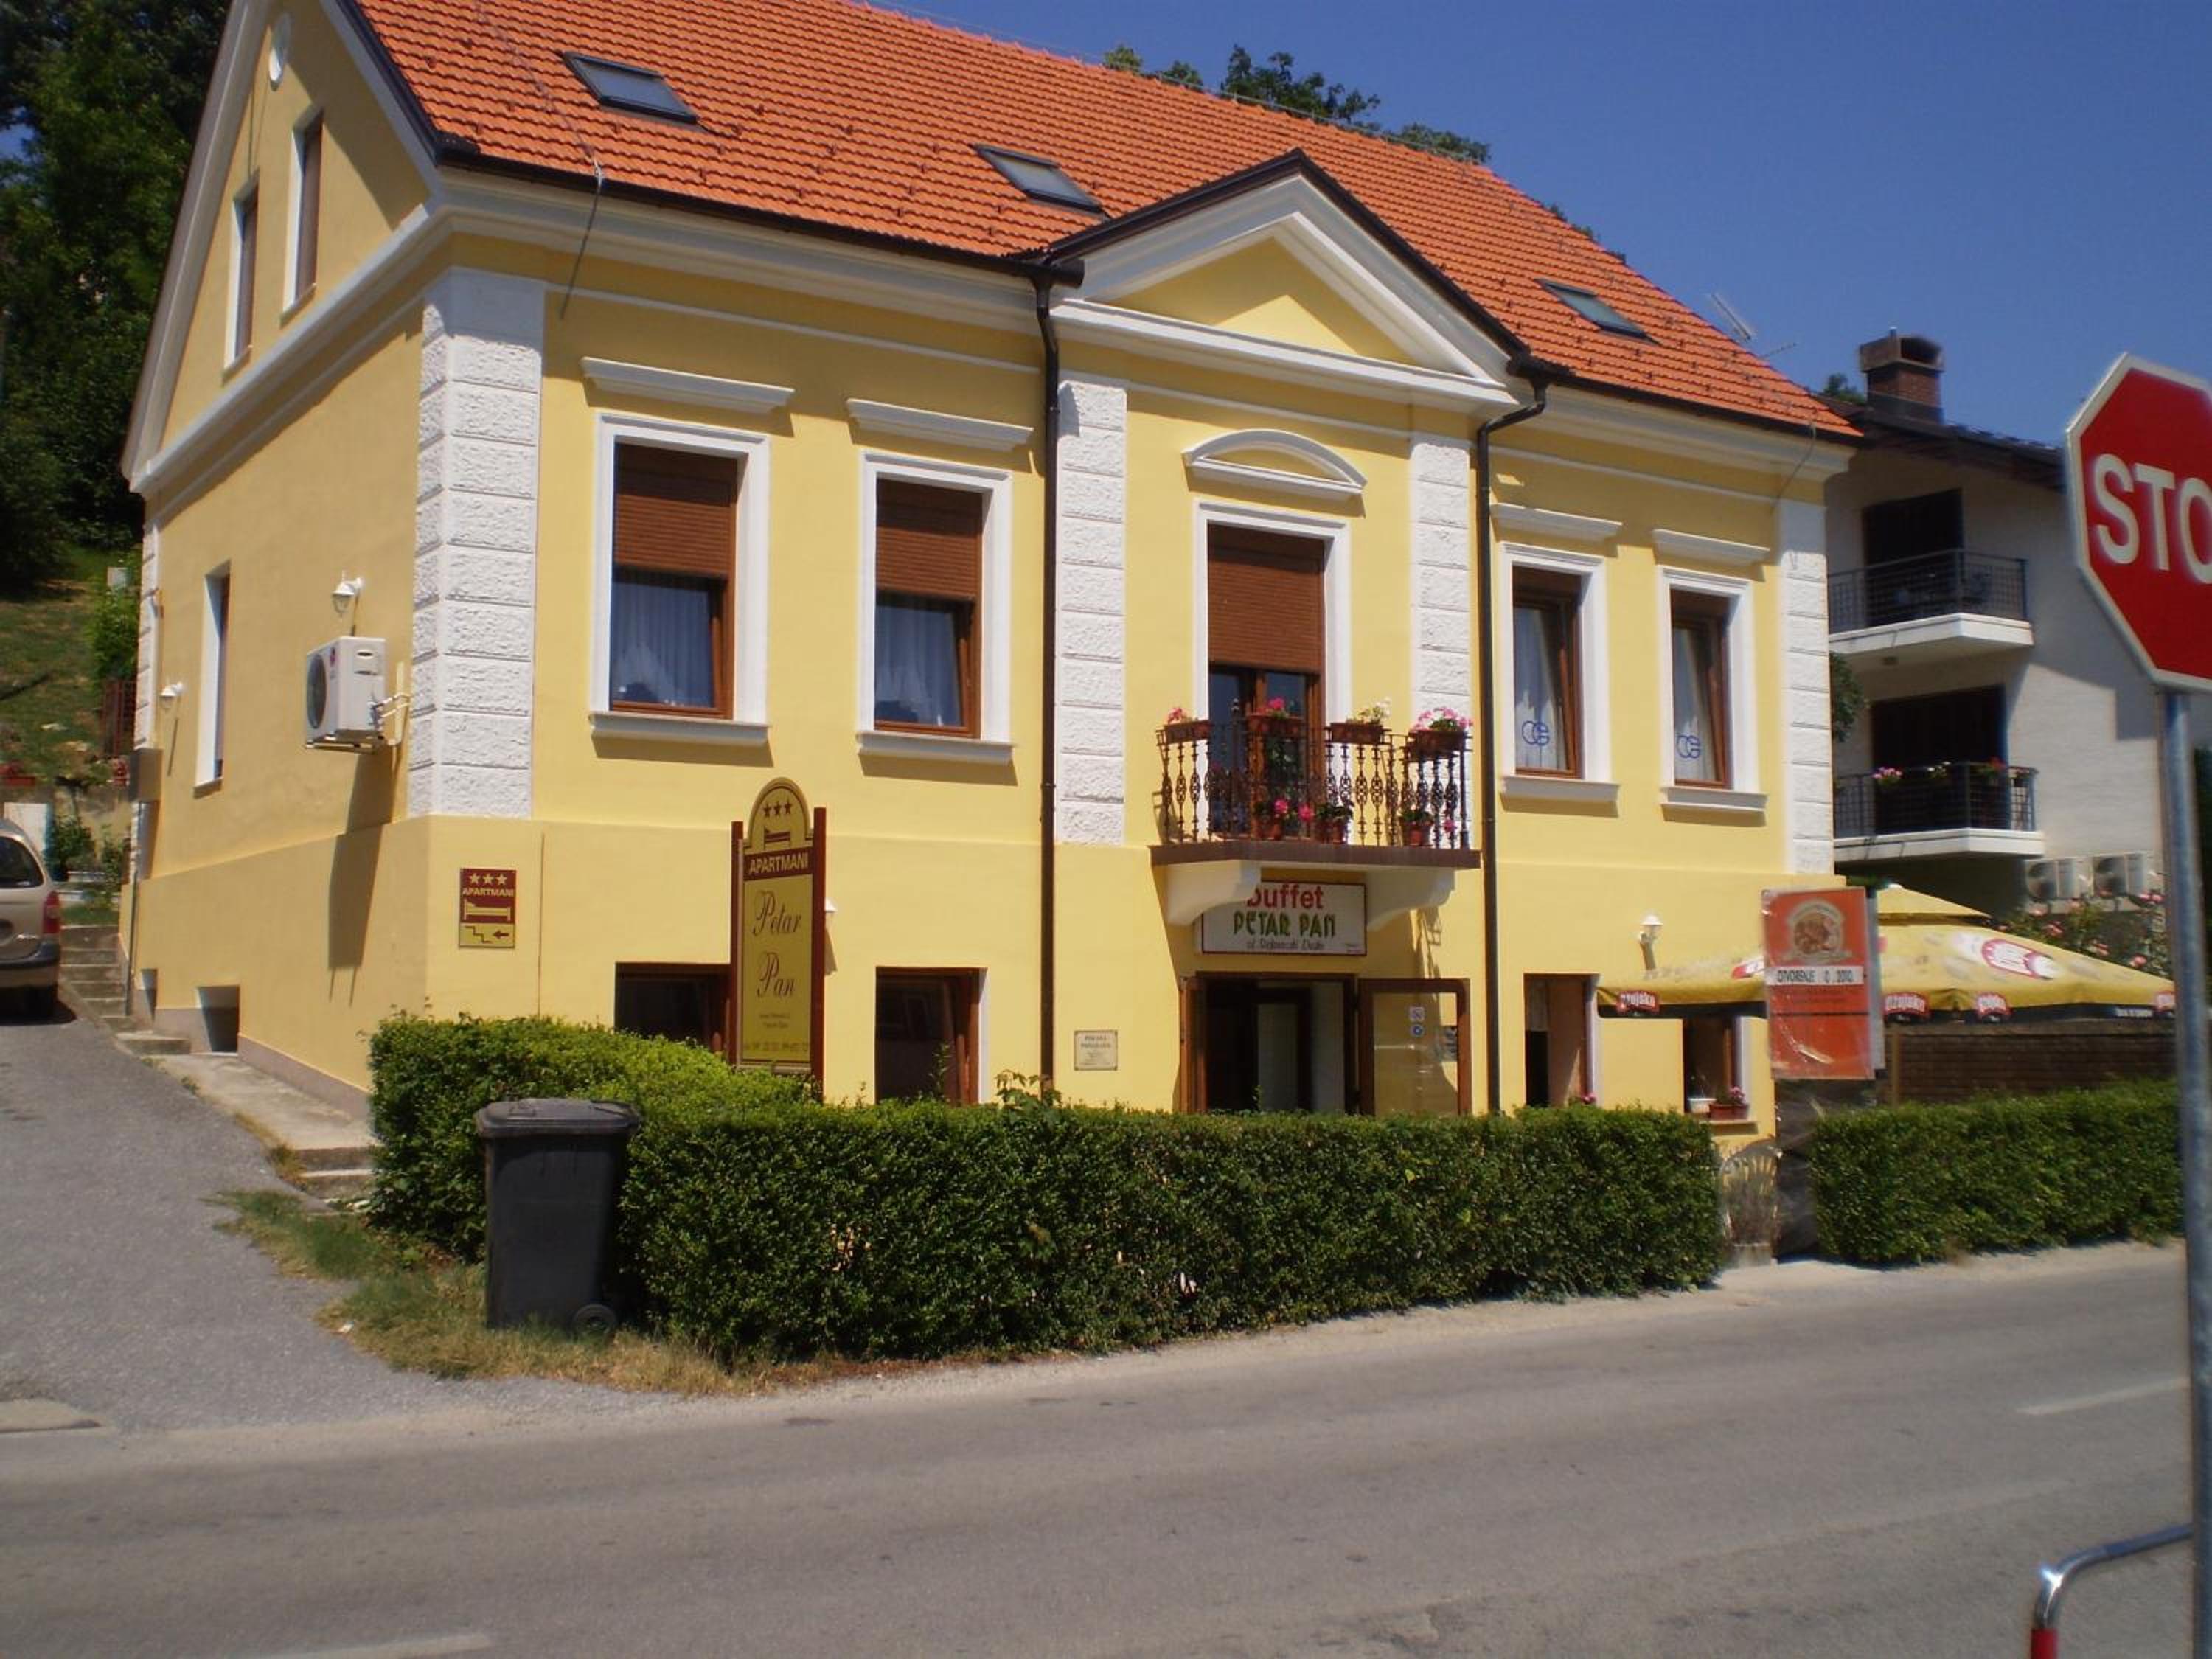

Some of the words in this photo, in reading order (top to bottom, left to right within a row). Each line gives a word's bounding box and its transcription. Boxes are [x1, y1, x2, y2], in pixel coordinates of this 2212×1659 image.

[749, 851, 809, 874] APARTMANI
[462, 886, 515, 897] APARTMANI
[752, 889, 802, 936] Petar
[1233, 910, 1291, 937] PETAR
[1298, 913, 1336, 939] PAN
[757, 951, 796, 998] Pan
